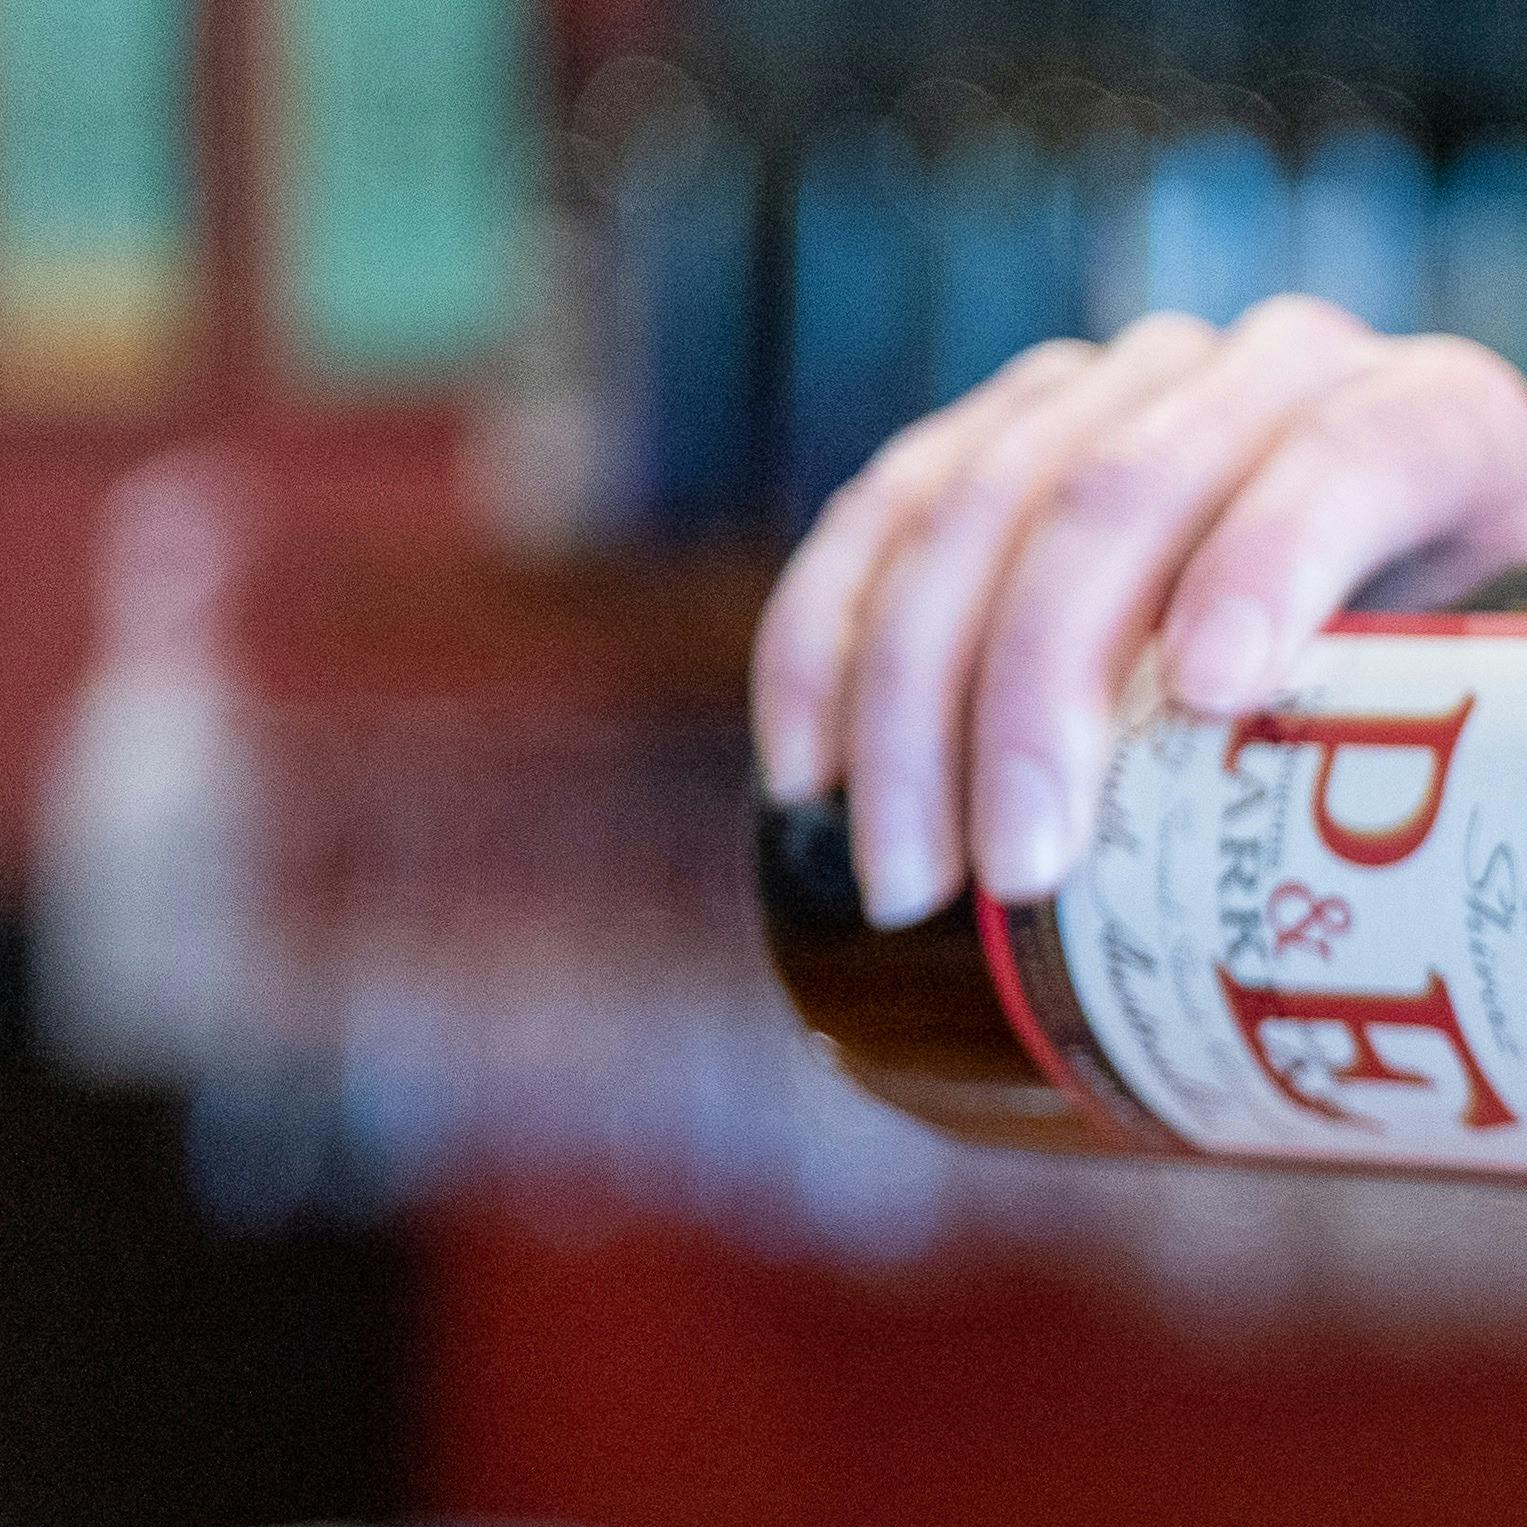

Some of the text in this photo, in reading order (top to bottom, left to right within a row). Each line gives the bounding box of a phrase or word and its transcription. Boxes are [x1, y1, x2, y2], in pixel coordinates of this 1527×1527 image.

[1214, 687, 1522, 1134] P & E
